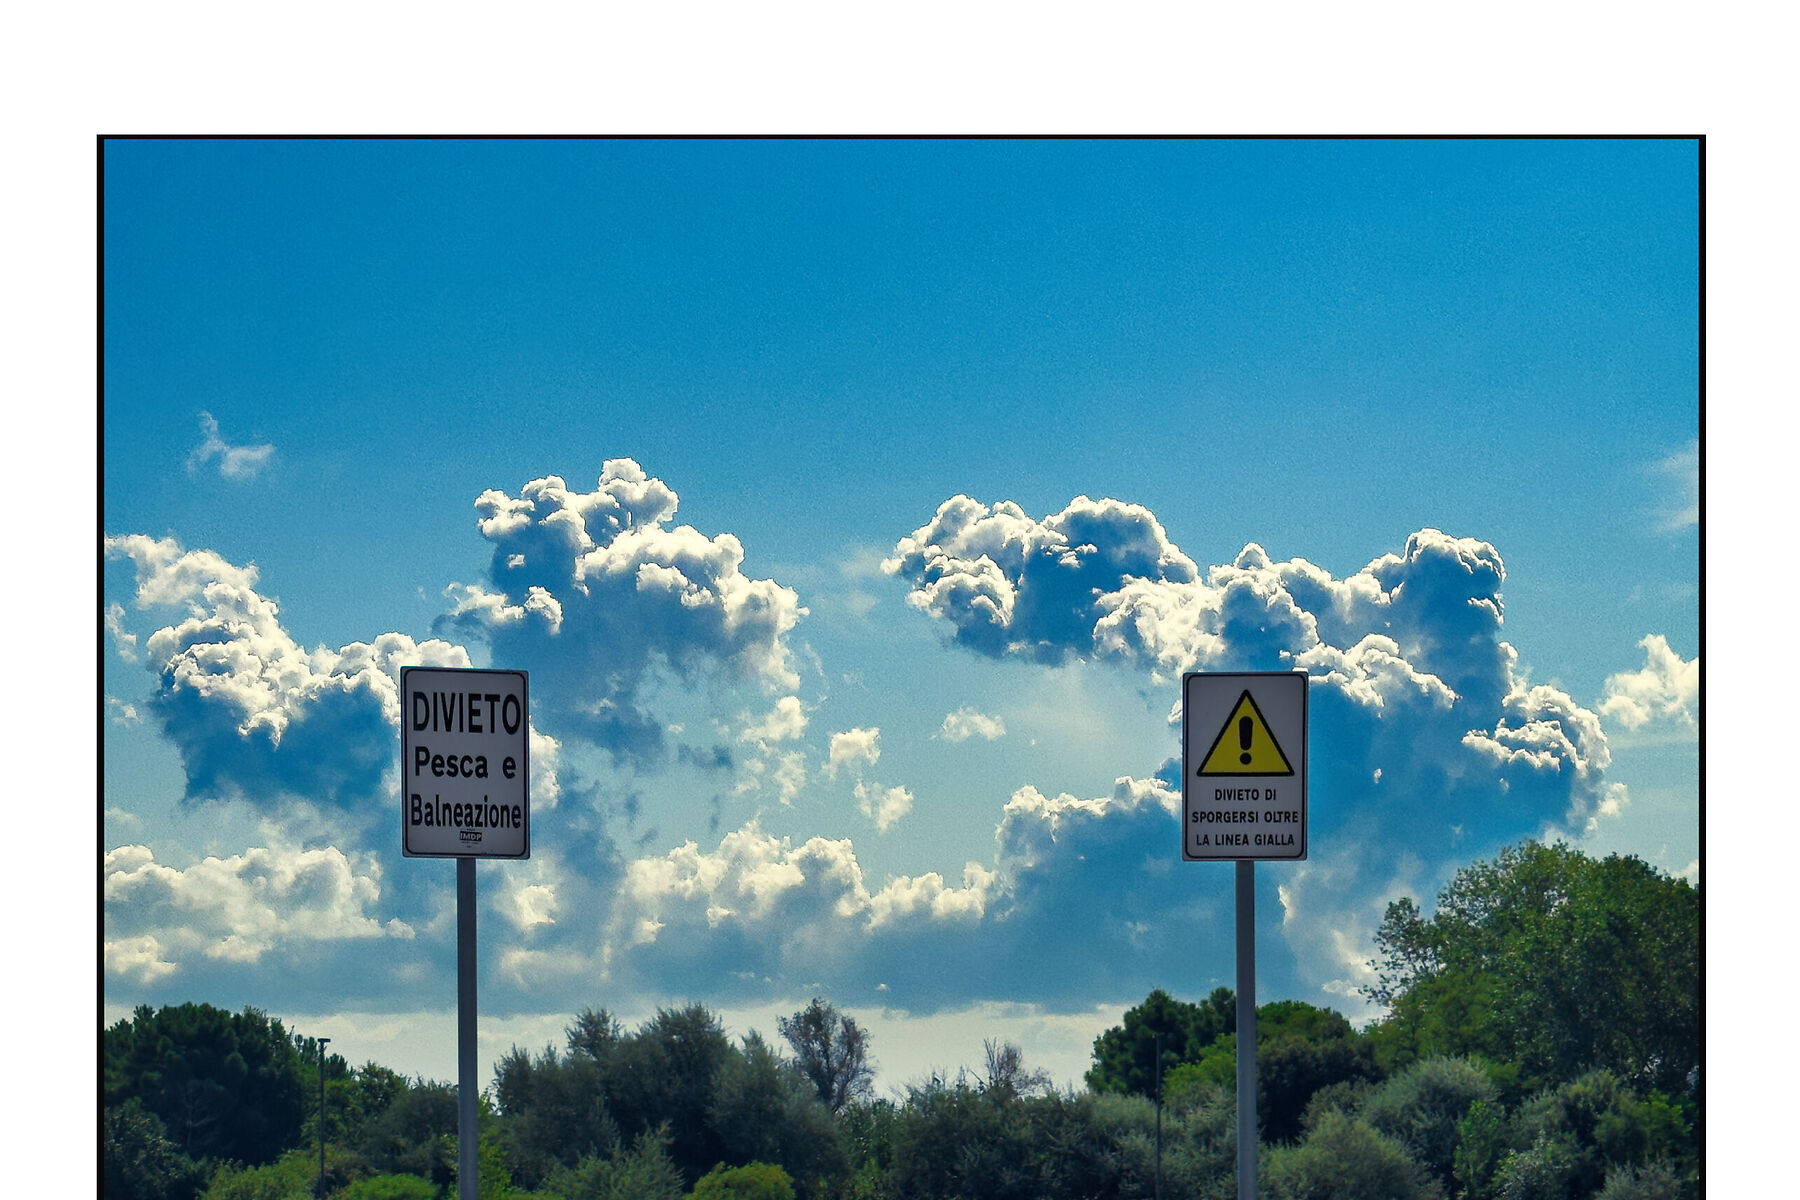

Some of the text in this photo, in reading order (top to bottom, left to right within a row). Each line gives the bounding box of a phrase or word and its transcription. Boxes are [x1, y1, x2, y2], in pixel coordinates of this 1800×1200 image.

[413, 691, 521, 735] DIVIETO
[415, 746, 517, 779] Pesca e
[1215, 789, 1276, 801] DIVIETO DI
[411, 794, 521, 828] Balneazione
[1192, 811, 1299, 824] SPORGERSI OLTRE
[1196, 834, 1294, 846] LA LINEA GIALLA
